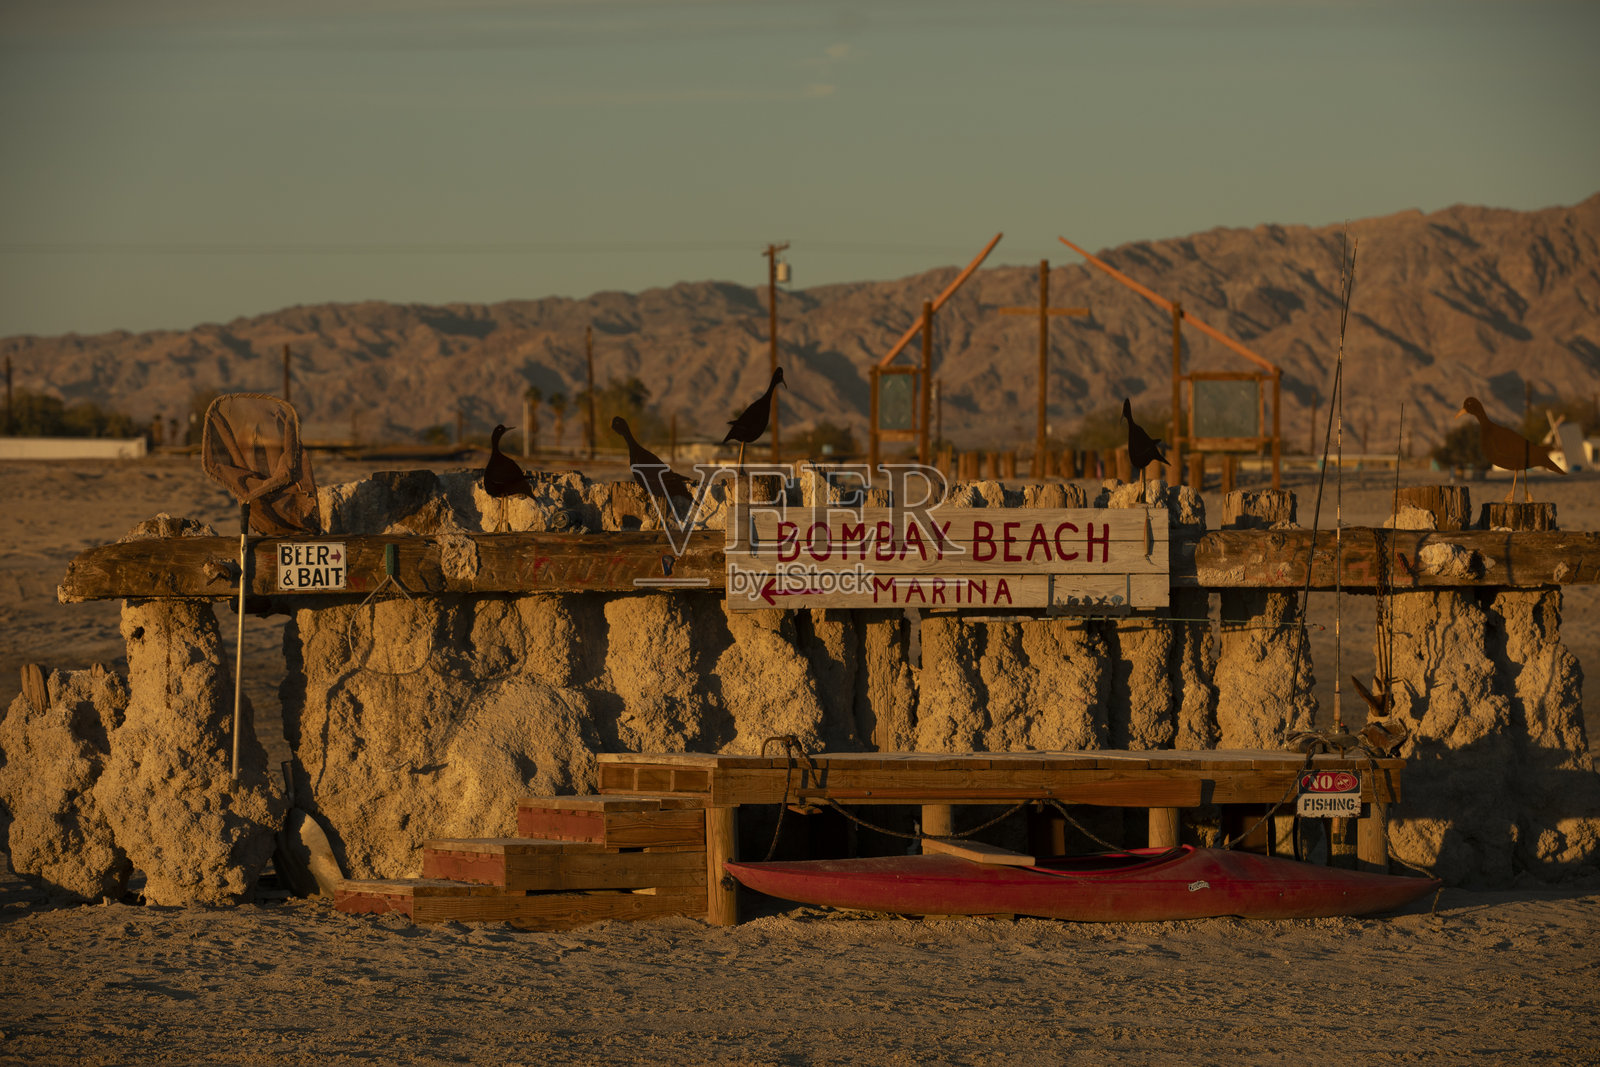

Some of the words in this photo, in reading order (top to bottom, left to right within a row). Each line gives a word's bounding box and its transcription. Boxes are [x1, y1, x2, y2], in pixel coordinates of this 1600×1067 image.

[777, 521, 951, 562] BOMBAY
[973, 522, 1110, 563] BEACH
[281, 546, 329, 565] BEER
[283, 569, 294, 585] &
[298, 567, 342, 586] BAIT
[873, 577, 1013, 604] MARINA
[1303, 798, 1354, 811] FISHING
